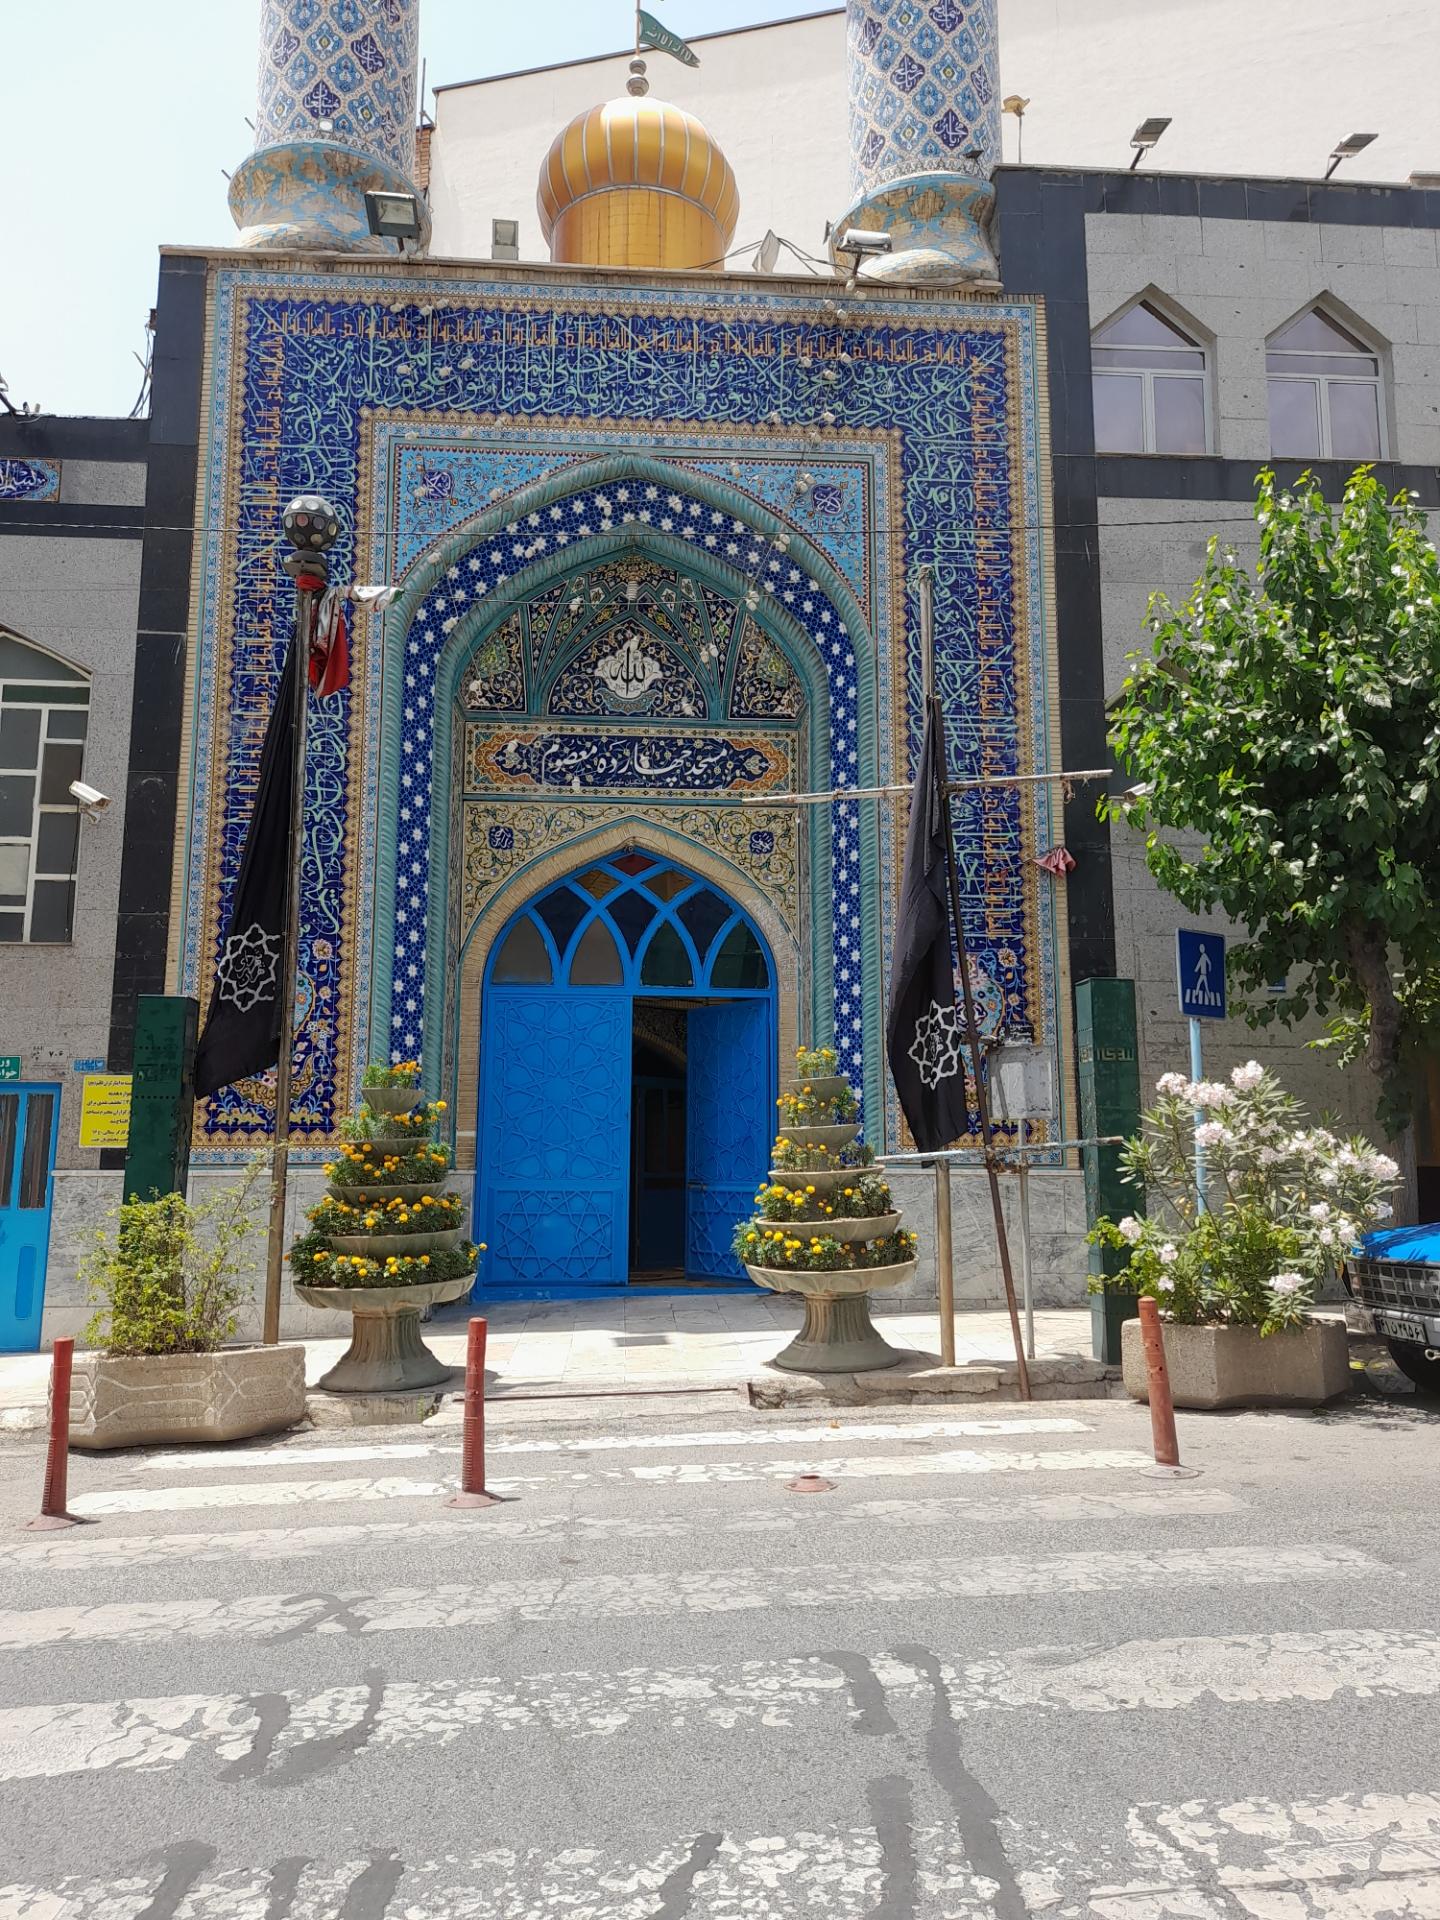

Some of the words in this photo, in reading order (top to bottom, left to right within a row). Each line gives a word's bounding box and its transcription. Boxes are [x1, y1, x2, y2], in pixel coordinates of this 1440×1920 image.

[609, 647, 646, 697] الله
[541, 744, 598, 785] معصوم
[597, 742, 692, 786] چهارده
[684, 748, 727, 785] مسجد
